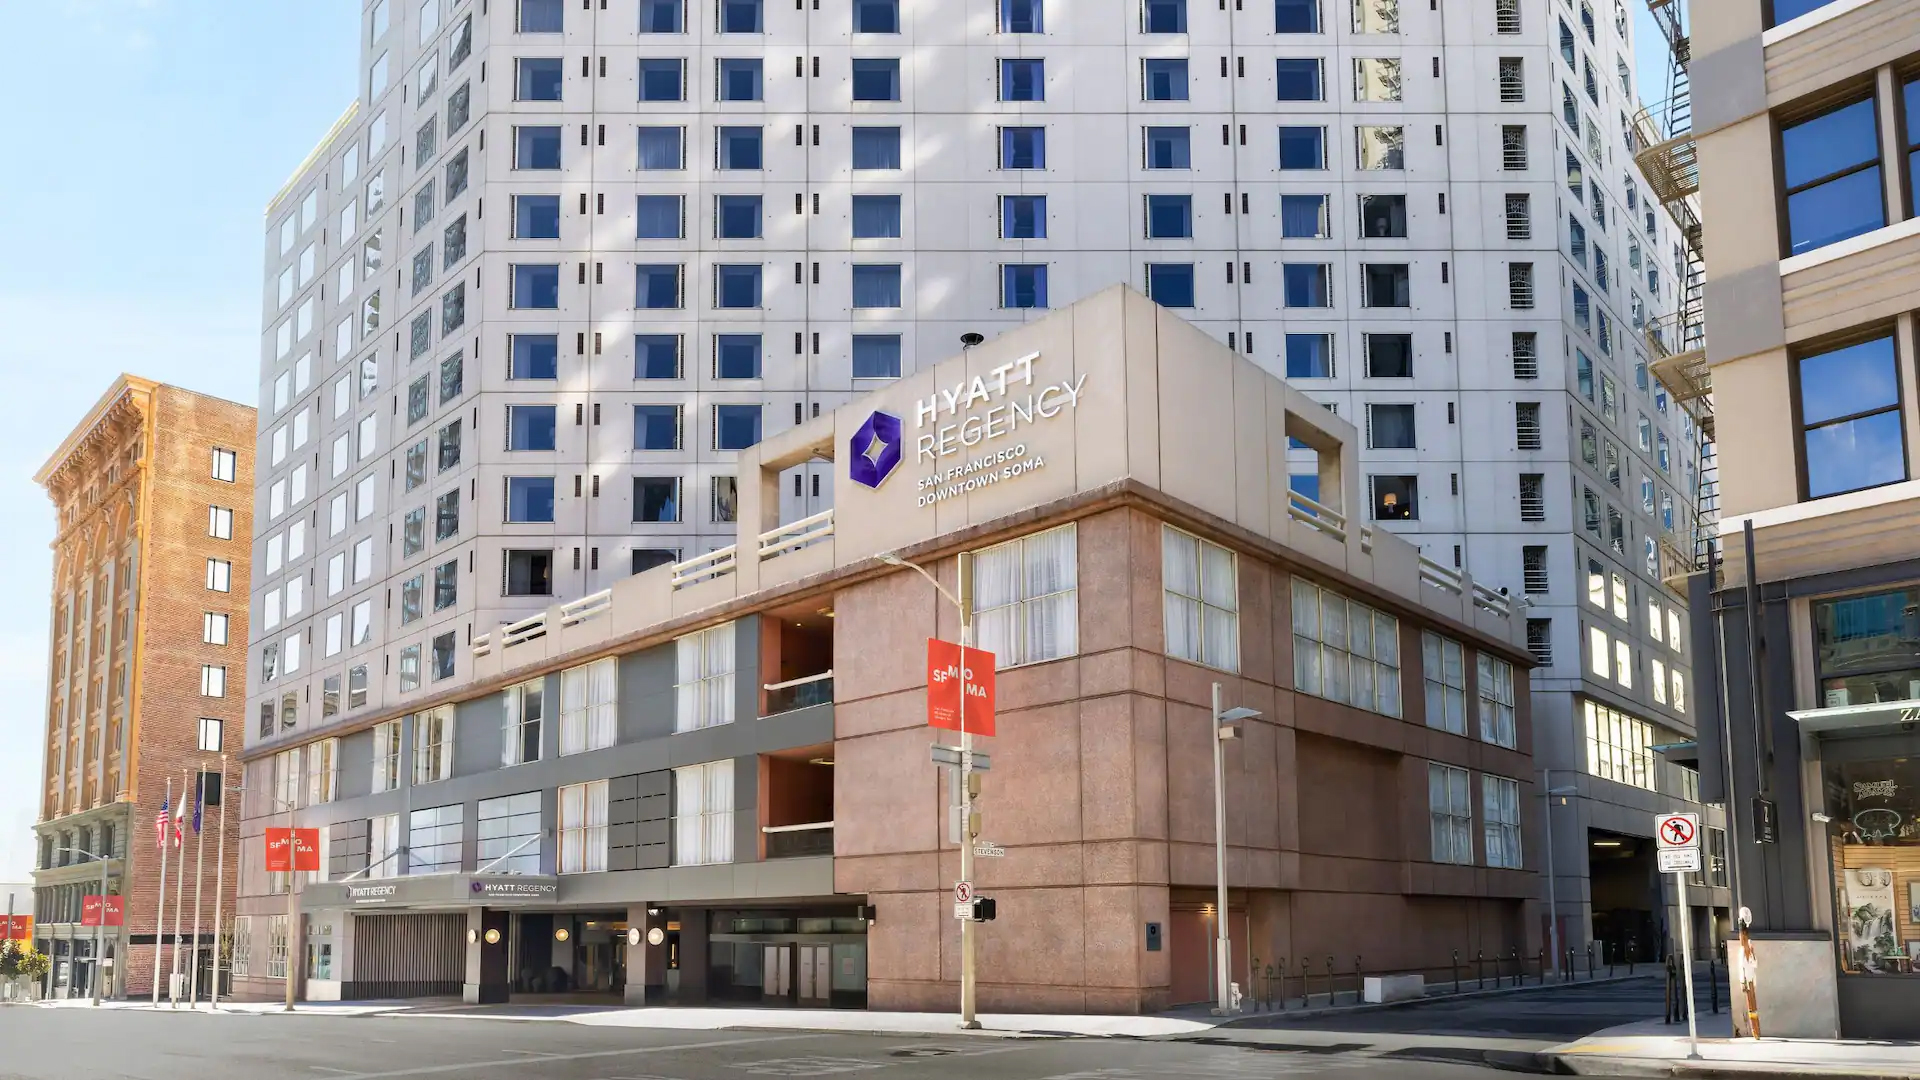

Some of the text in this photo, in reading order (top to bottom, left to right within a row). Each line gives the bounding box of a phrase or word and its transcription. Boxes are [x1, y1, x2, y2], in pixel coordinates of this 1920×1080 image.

[917, 350, 1041, 428] HYATT
[917, 373, 1087, 464] REGENCY
[917, 444, 1026, 491] SAN FRANCISCO
[917, 456, 1045, 508] DOWNTOWN SOMA
[974, 848, 1004, 856] STEVENSON
[370, 885, 397, 896] REGENCY
[485, 884, 557, 892] HYATT REGENCY
